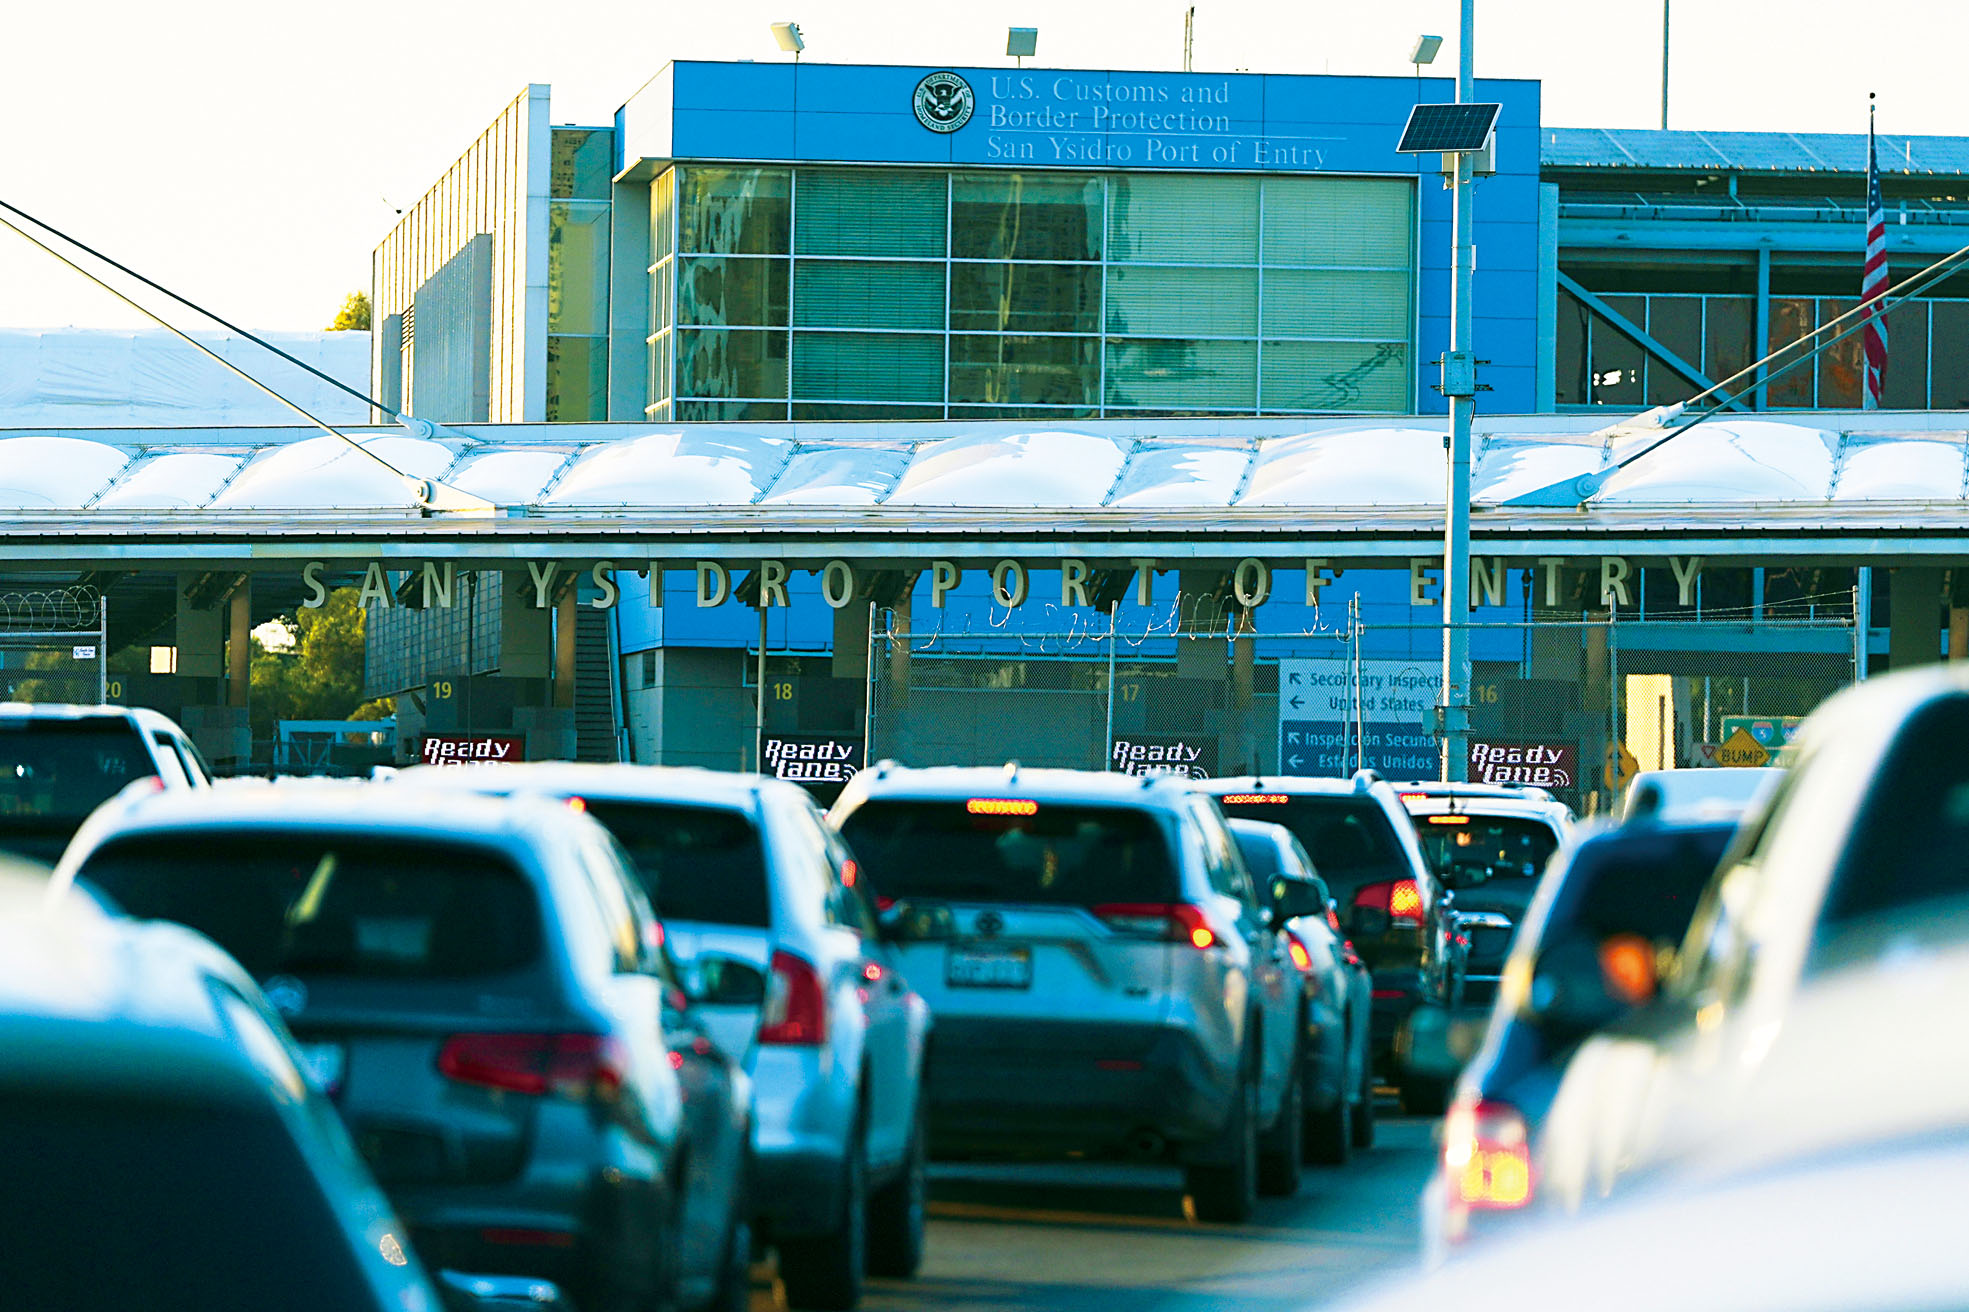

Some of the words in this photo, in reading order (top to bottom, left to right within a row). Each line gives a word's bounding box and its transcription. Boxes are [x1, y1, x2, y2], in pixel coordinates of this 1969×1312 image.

[991, 76, 1040, 99] U.S.
[1053, 76, 1169, 103] Customs
[1181, 81, 1229, 103] and
[990, 104, 1079, 128] Border
[1093, 105, 1229, 132] Protection
[987, 135, 1034, 159] San
[1048, 136, 1132, 161] Ysidro
[1147, 138, 1200, 163] Port
[1212, 140, 1241, 163] of
[1254, 141, 1328, 170] Entry
[302, 561, 452, 608] SAN
[528, 560, 856, 608] YSIDRO
[932, 558, 1159, 609] PORT
[1234, 557, 1330, 608] OF
[1410, 556, 1705, 607] ENTRY
[433, 681, 452, 699] 19
[773, 682, 793, 700] 18
[1310, 673, 1382, 690] Secodary
[1389, 674, 1444, 690] Inspecti
[1122, 683, 1139, 702] 17
[1476, 684, 1498, 704] 16
[1330, 696, 1374, 711] Untd
[1382, 696, 1425, 711] States
[424, 738, 511, 763] Ready
[1305, 731, 1381, 750] Inspecón
[1385, 733, 1443, 748] Secund
[765, 739, 853, 765] Ready
[1113, 741, 1202, 766] Ready
[1320, 754, 1377, 769] Estds
[1383, 754, 1434, 769] Unidos
[1471, 743, 1563, 768] Ready
[1720, 749, 1764, 763] BUMP
